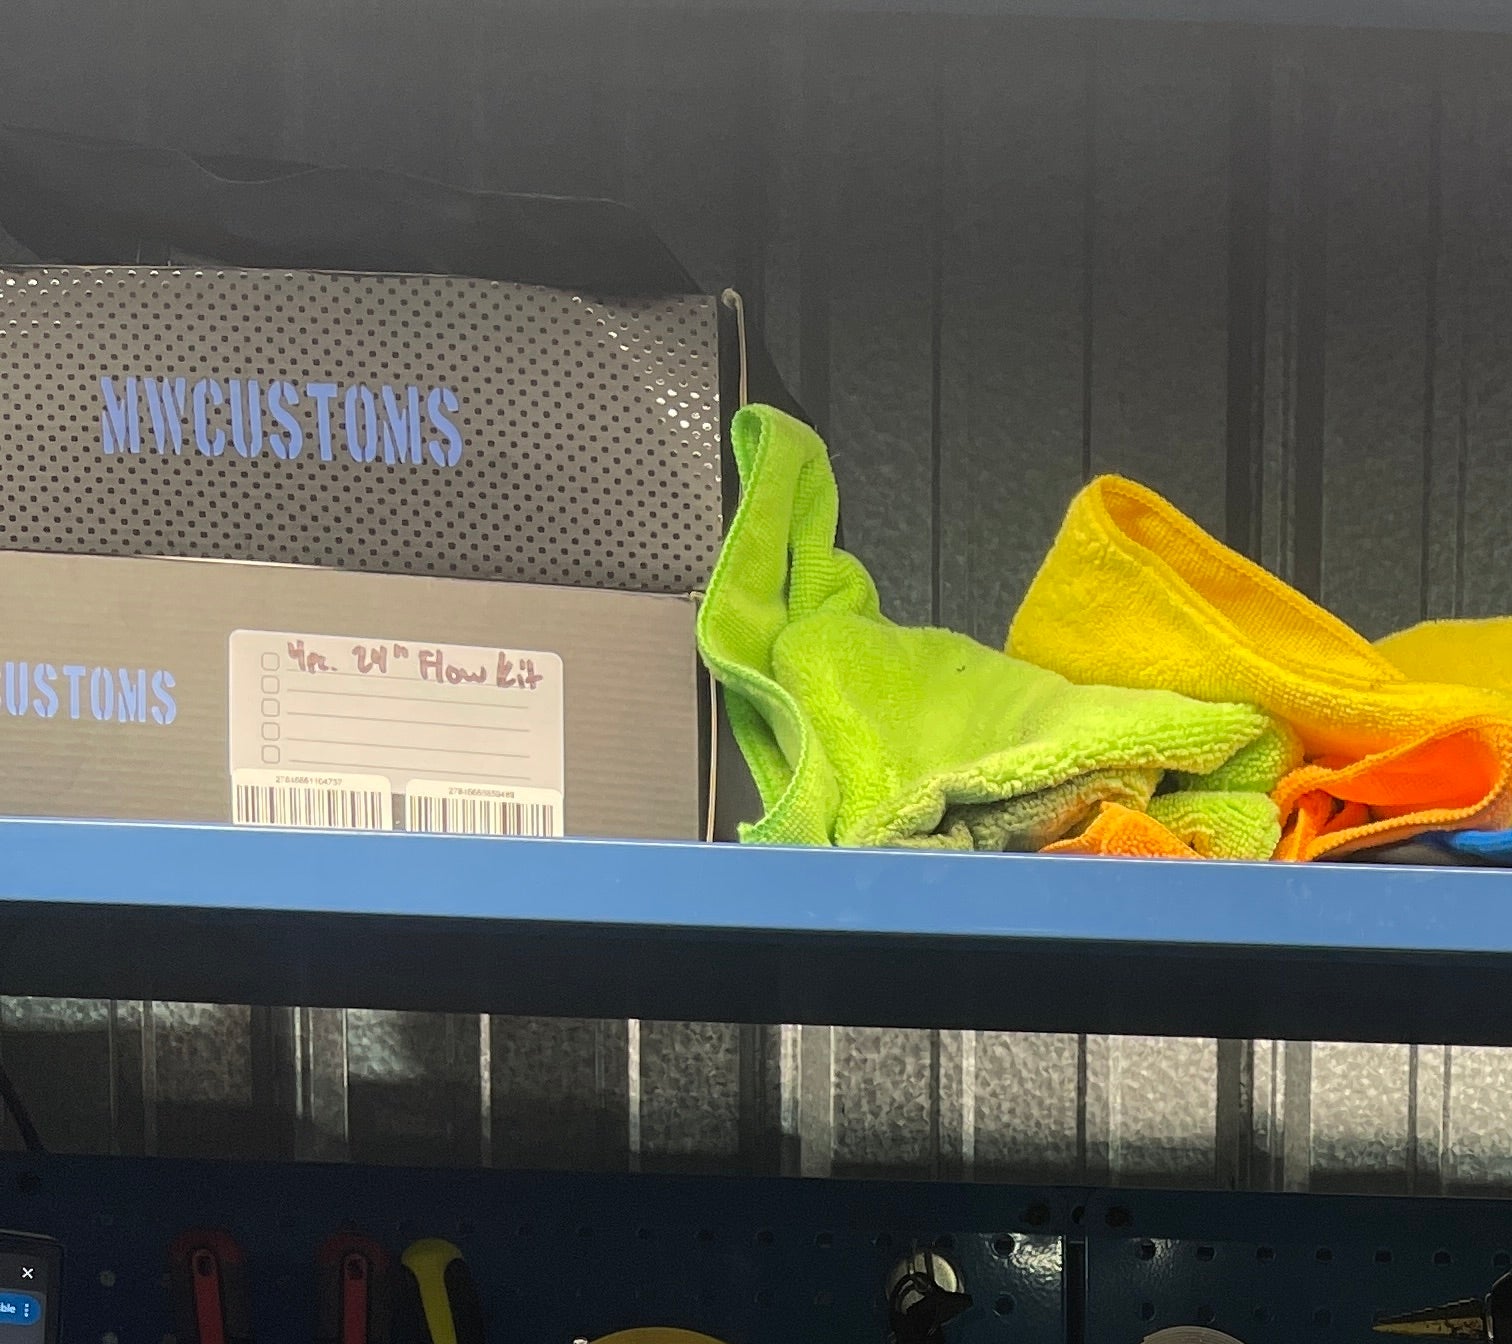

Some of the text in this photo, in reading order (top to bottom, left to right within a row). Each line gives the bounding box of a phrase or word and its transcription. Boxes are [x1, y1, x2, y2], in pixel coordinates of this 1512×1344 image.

[101, 376, 463, 467] MWCUSTOMS
[419, 649, 486, 684] Flow
[0, 661, 177, 725] USTOMS
[0, 1302, 16, 1314] ble
